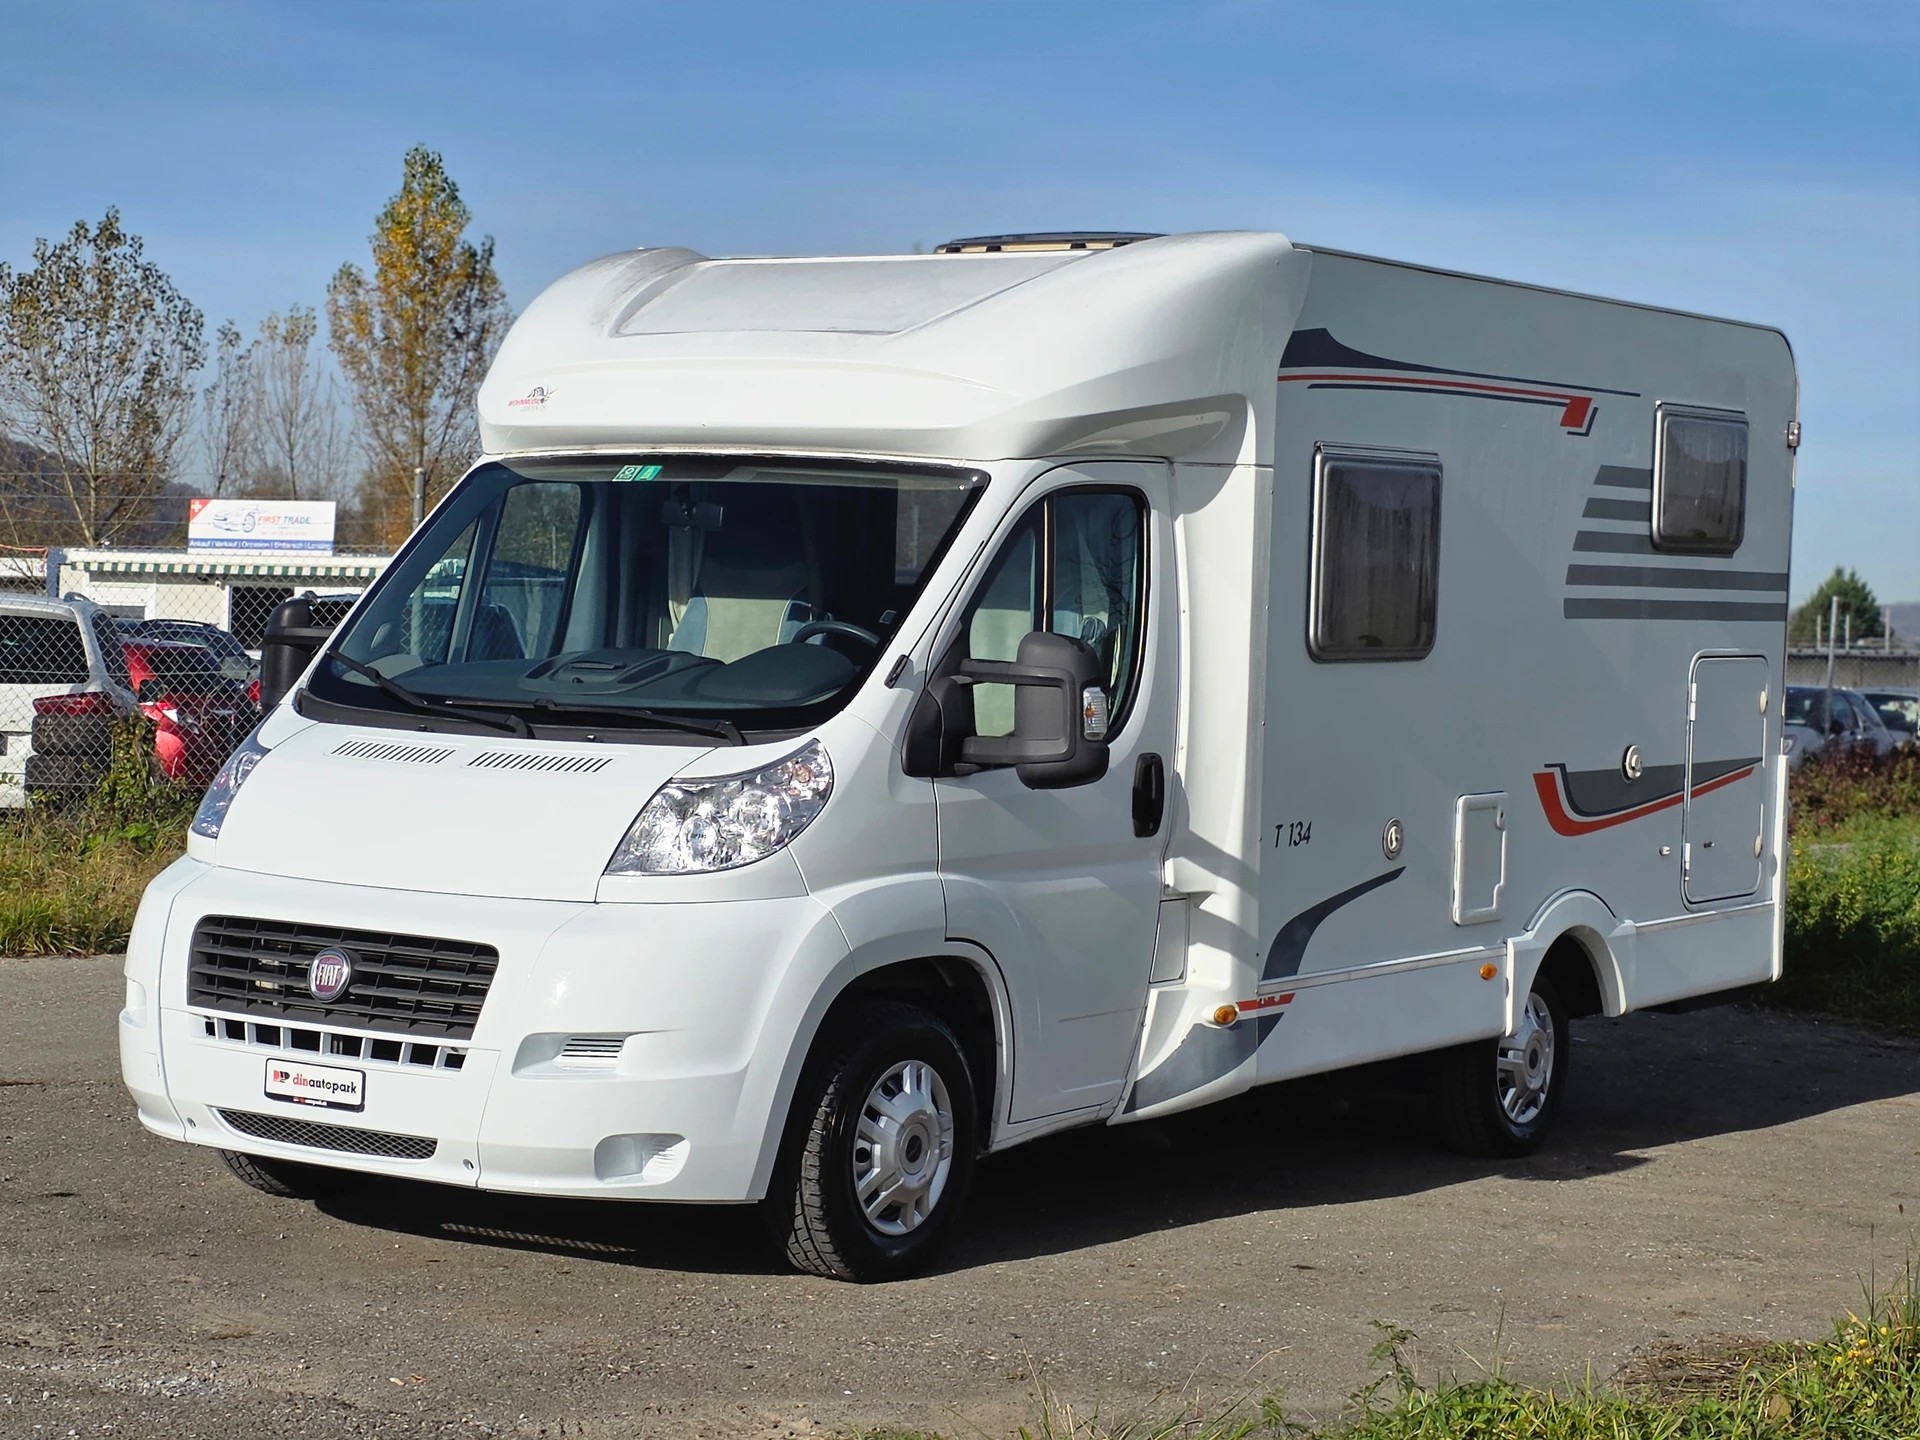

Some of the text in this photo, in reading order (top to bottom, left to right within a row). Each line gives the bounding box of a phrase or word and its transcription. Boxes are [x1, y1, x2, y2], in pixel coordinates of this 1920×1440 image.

[258, 516, 312, 525] FIRST TRADE
[1275, 820, 1312, 849] T 134
[316, 963, 342, 987] FIAT
[292, 1073, 357, 1094] dinautopark
